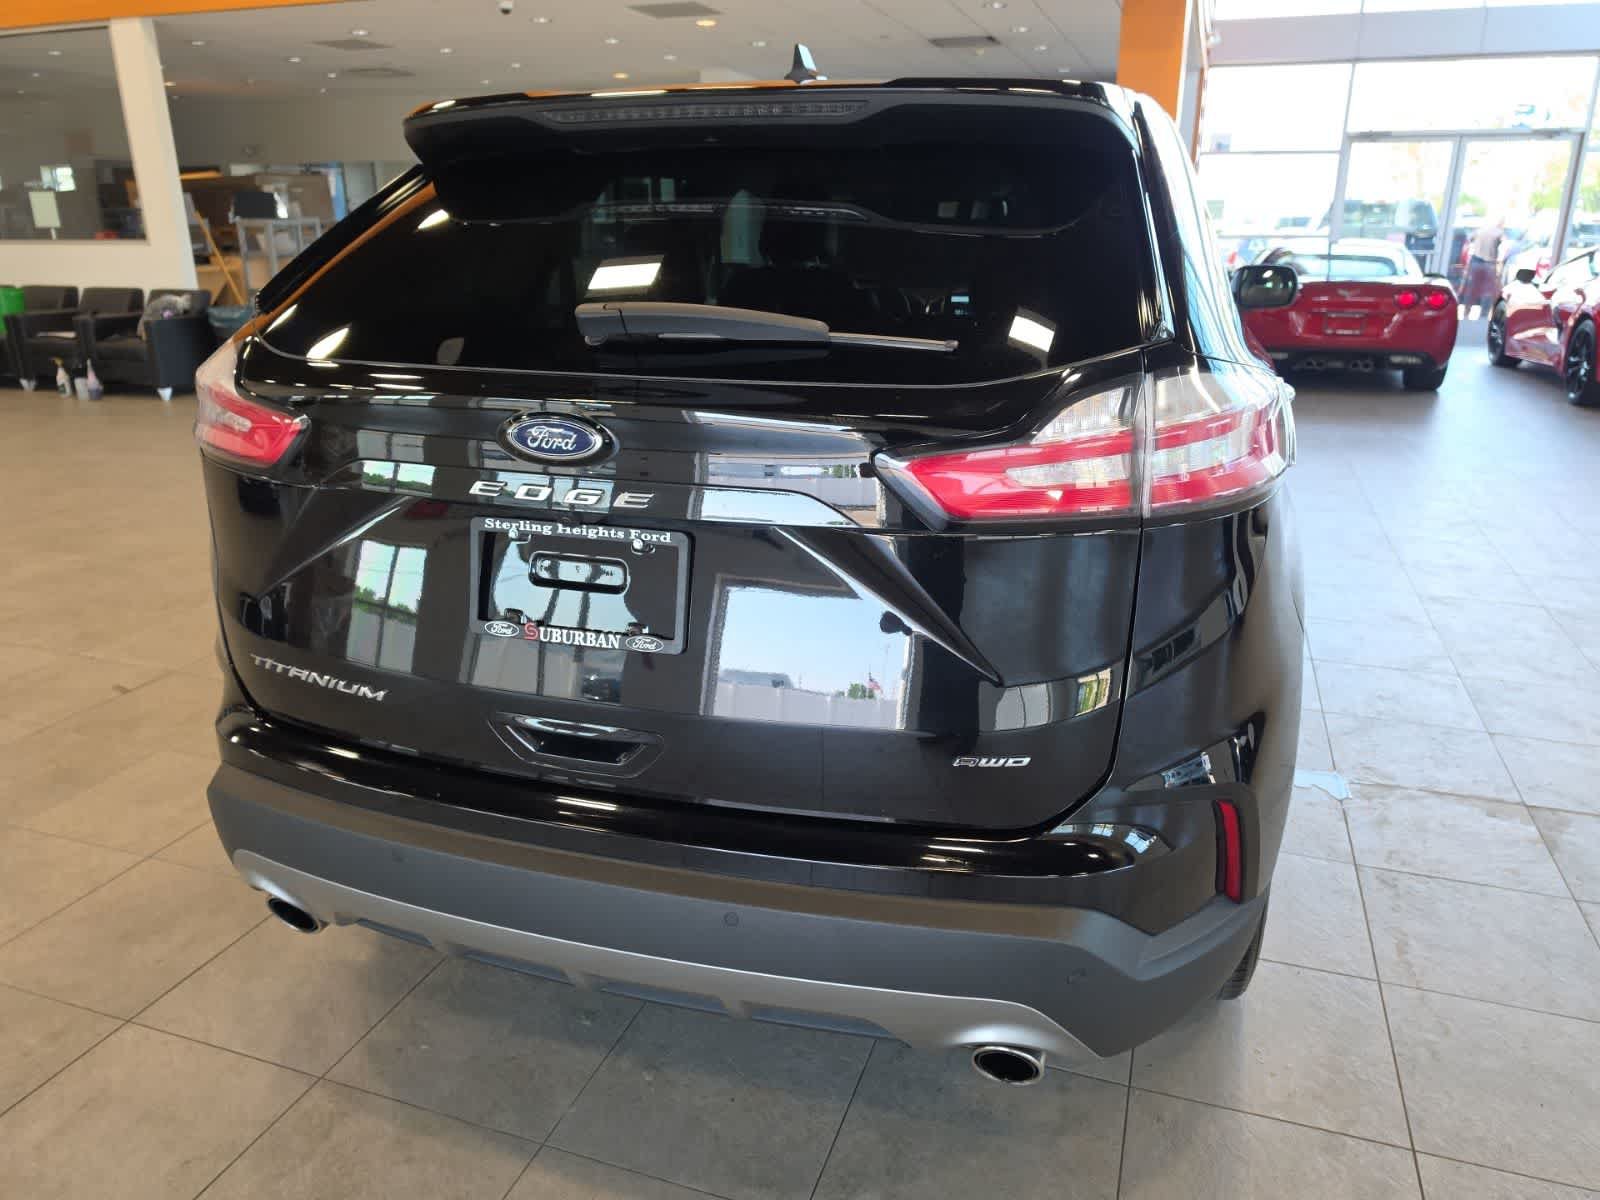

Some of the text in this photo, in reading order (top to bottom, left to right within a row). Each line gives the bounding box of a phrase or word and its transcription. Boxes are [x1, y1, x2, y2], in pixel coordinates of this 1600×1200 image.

[526, 425, 578, 451] Ford
[468, 480, 655, 509] EDGE
[484, 518, 672, 544] Sterling Heights Ford
[523, 622, 621, 649] SUBURBAN
[250, 653, 389, 701] TITANIUM
[952, 757, 1031, 768] AWD
